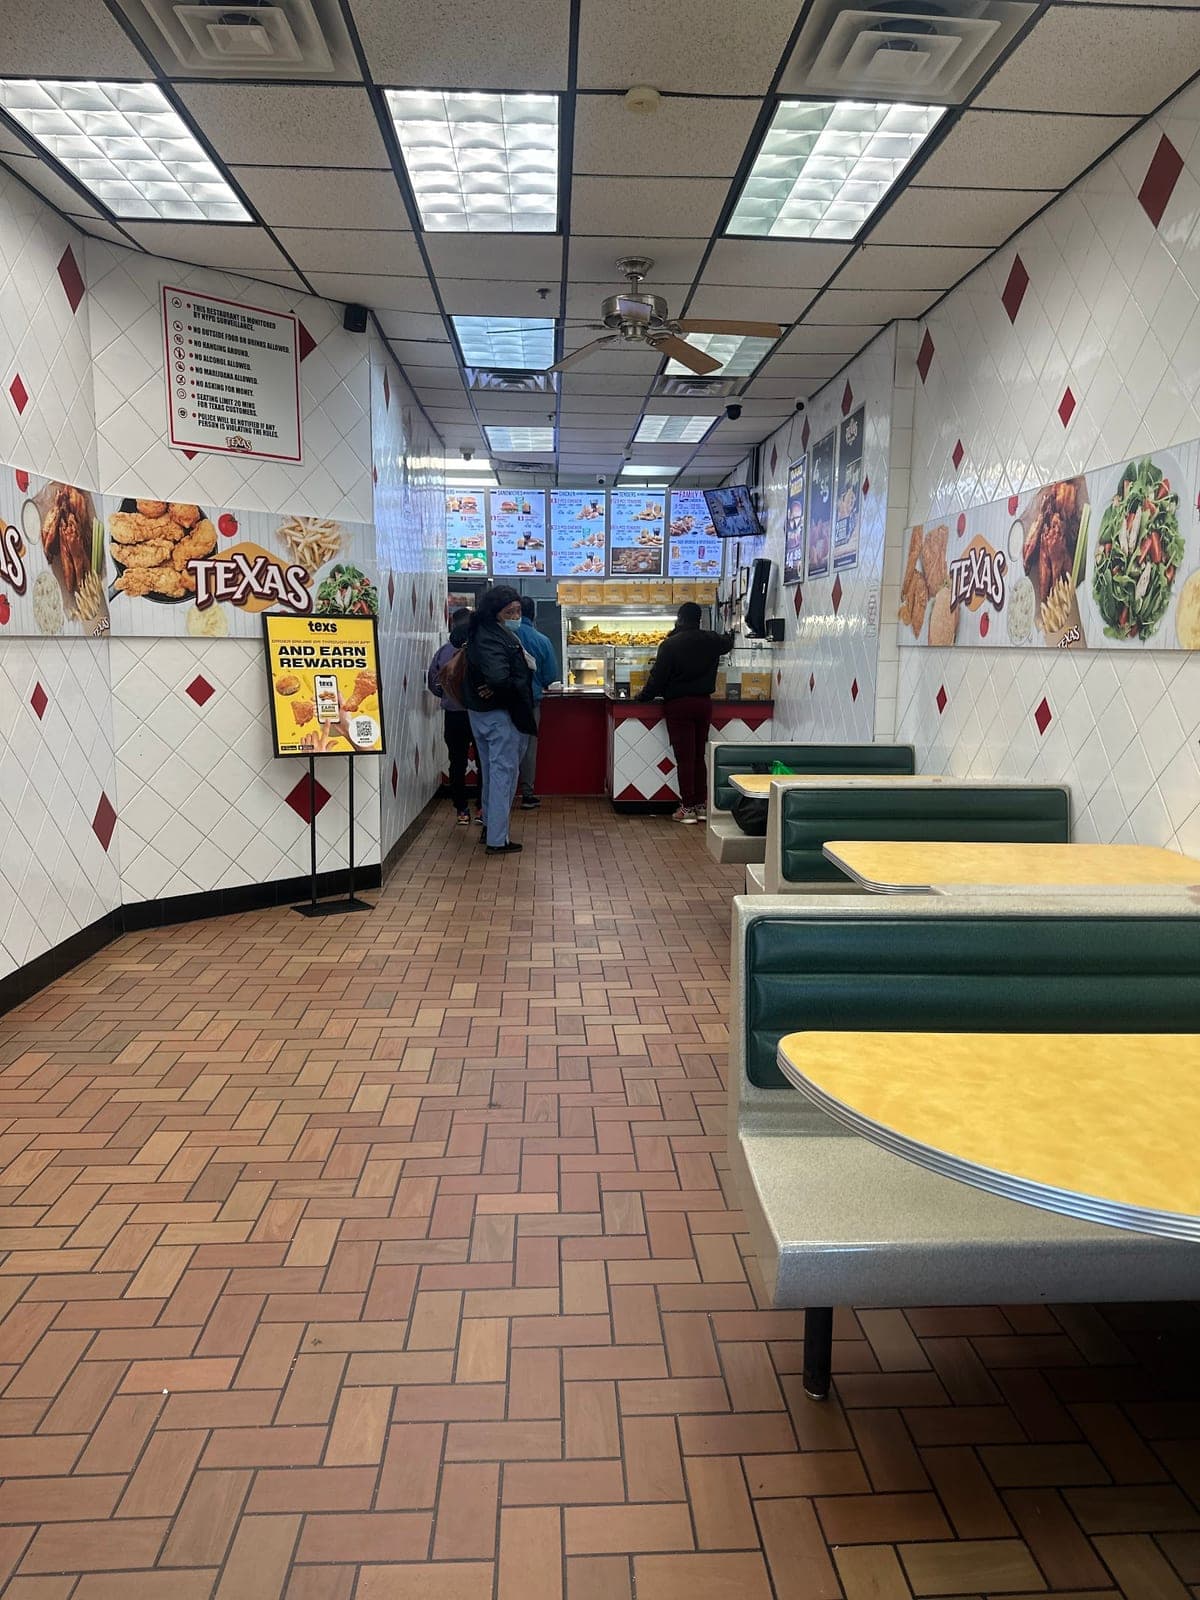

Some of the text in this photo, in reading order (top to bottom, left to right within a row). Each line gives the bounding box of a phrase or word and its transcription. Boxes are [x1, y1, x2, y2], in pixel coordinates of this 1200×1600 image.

[193, 304, 205, 312] THIS
[207, 307, 239, 320] RESTAURANT
[247, 317, 276, 329] MONITORED
[202, 313, 216, 322] NYPD
[202, 328, 224, 339] OUTSIDE
[225, 334, 238, 342] FOOD
[248, 339, 266, 348] DRINKS
[267, 342, 290, 353] ALLOWED.
[203, 342, 226, 352] HANGING
[228, 347, 249, 357] AROUND.
[203, 355, 225, 365] ALCOHOL
[228, 360, 251, 370] ALLOWED.
[204, 368, 233, 379] MARIJUANA
[235, 374, 259, 384] ALLOWED.
[205, 382, 224, 391] ASKING
[236, 388, 254, 396] MONEY.
[197, 394, 218, 403] SEATING
[220, 397, 233, 405] LIMIT
[209, 403, 224, 411] TEXAS
[226, 405, 257, 416] CUSTOMERS.
[198, 413, 216, 421] POLICE
[238, 419, 259, 428] NOTIFIED
[199, 420, 218, 429] PERSON
[226, 424, 252, 433] VIOLATING
[226, 436, 252, 450] TEXAS
[187, 554, 313, 614] TEXAS
[950, 547, 1006, 613] TEXAS
[308, 621, 337, 632] texs
[279, 646, 366, 656] AND EARN
[281, 658, 366, 668] REWARDS
